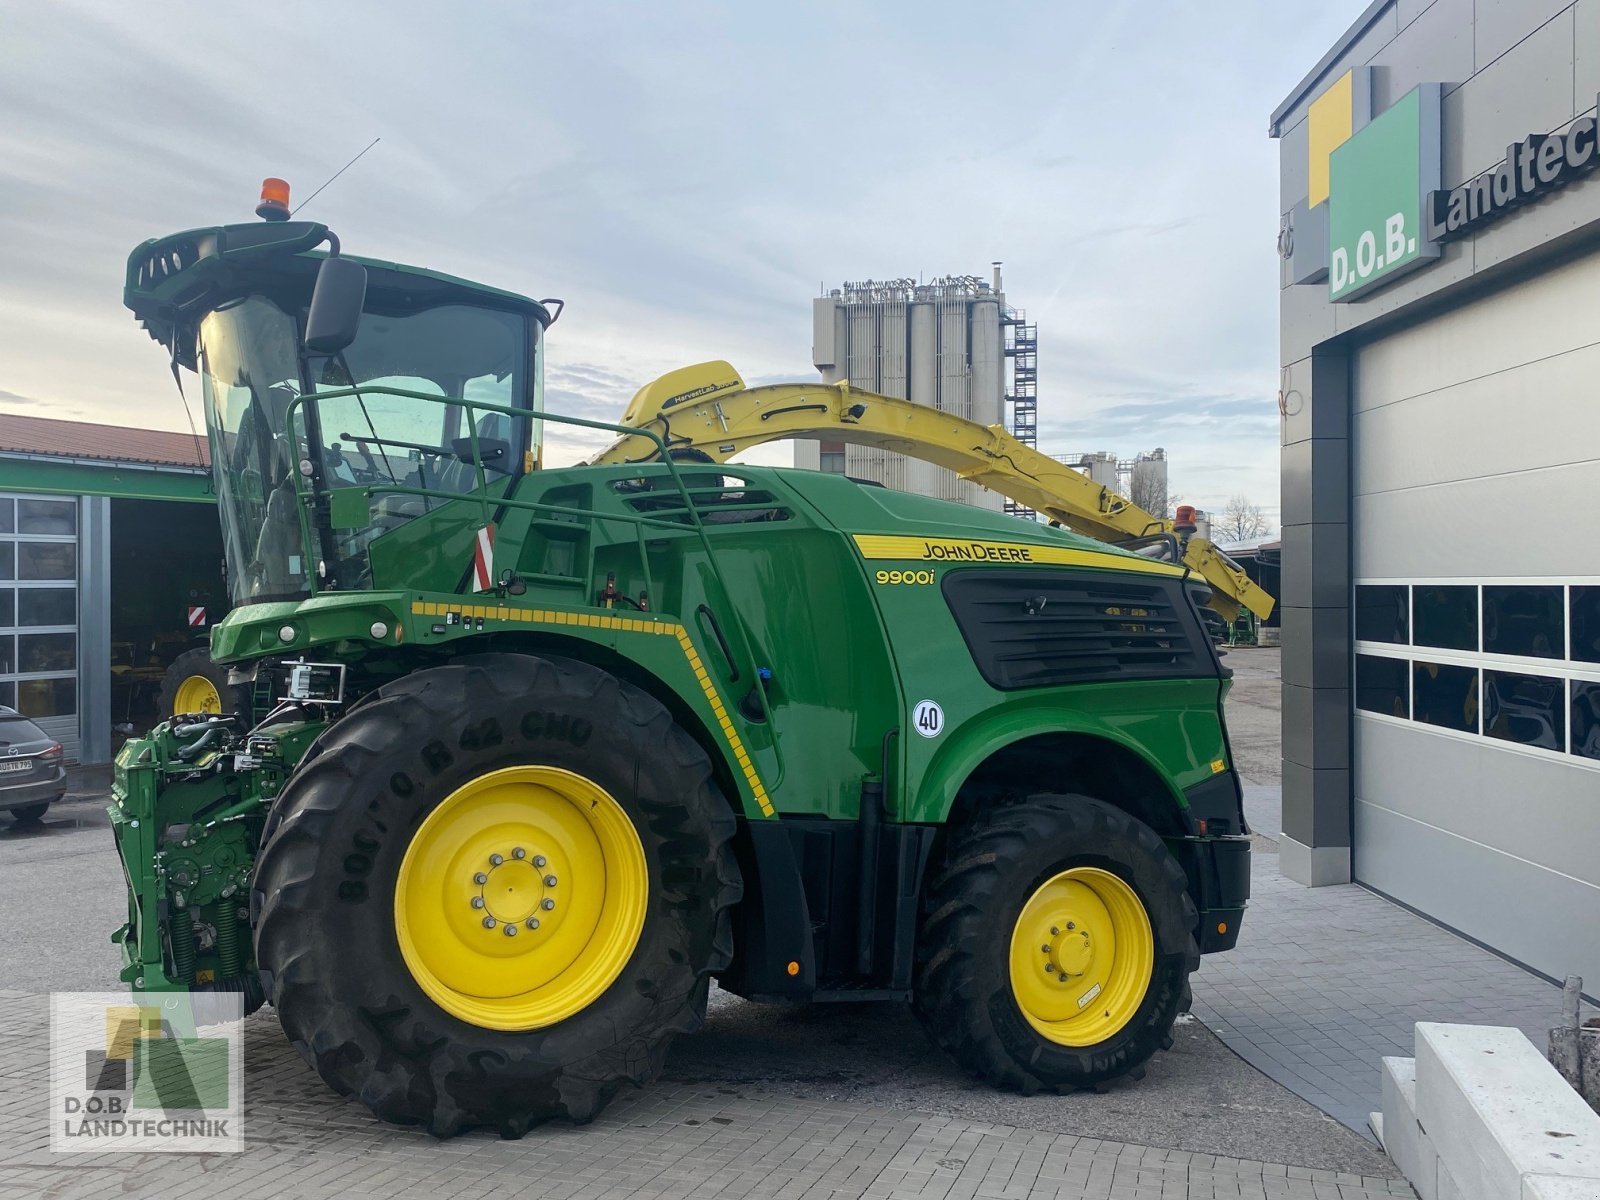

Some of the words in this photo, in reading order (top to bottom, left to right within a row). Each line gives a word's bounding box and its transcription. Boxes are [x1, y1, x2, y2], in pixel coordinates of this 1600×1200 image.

[1332, 212, 1415, 293] D.O.B.
[675, 386, 714, 403] HarvestLab
[923, 542, 972, 560] JOHN
[971, 544, 1033, 562] DEERE
[876, 569, 935, 585] 9900i
[919, 706, 938, 731] 40
